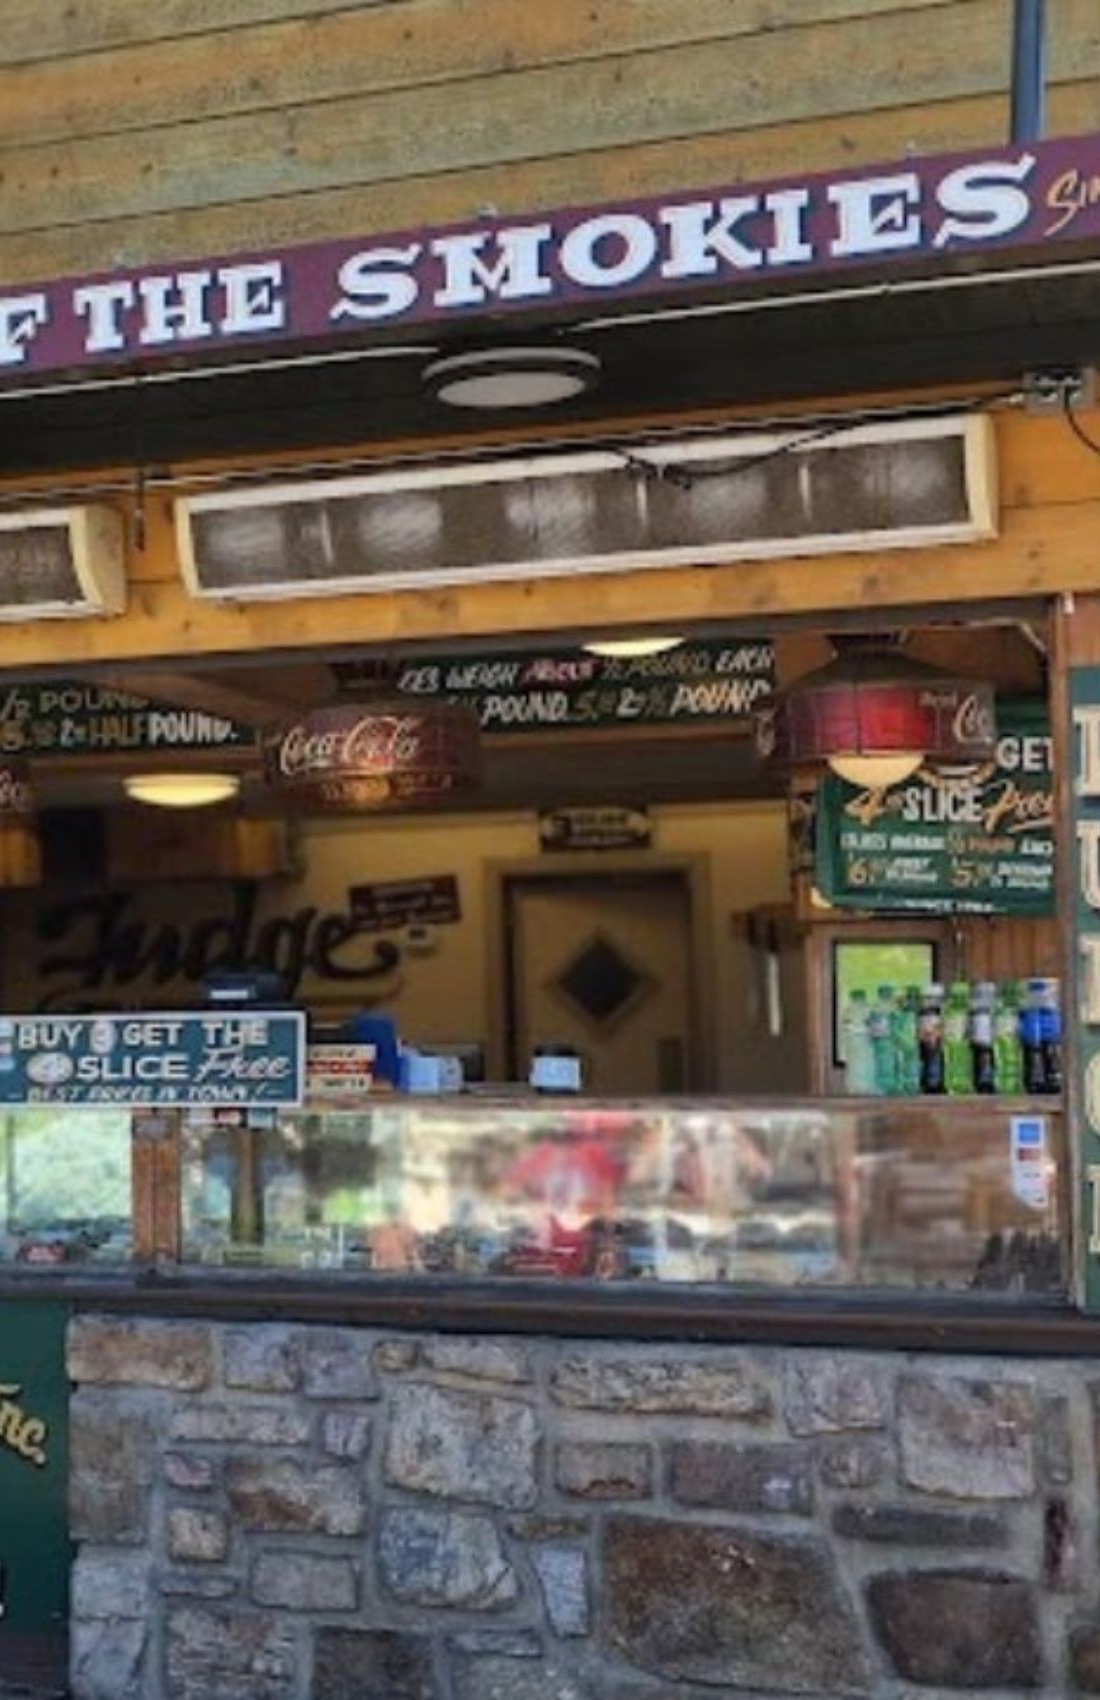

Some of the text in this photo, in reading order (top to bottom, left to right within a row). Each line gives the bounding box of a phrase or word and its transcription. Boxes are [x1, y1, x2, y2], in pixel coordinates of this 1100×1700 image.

[74, 260, 284, 352] THE
[329, 153, 1036, 320] SMOKIES
[901, 784, 985, 824] SLICE
[17, 1022, 84, 1050] BUY
[122, 1022, 184, 1047] GET
[202, 1020, 269, 1047] THE
[76, 1055, 190, 1082] SLICE
[193, 1047, 291, 1083] Free
